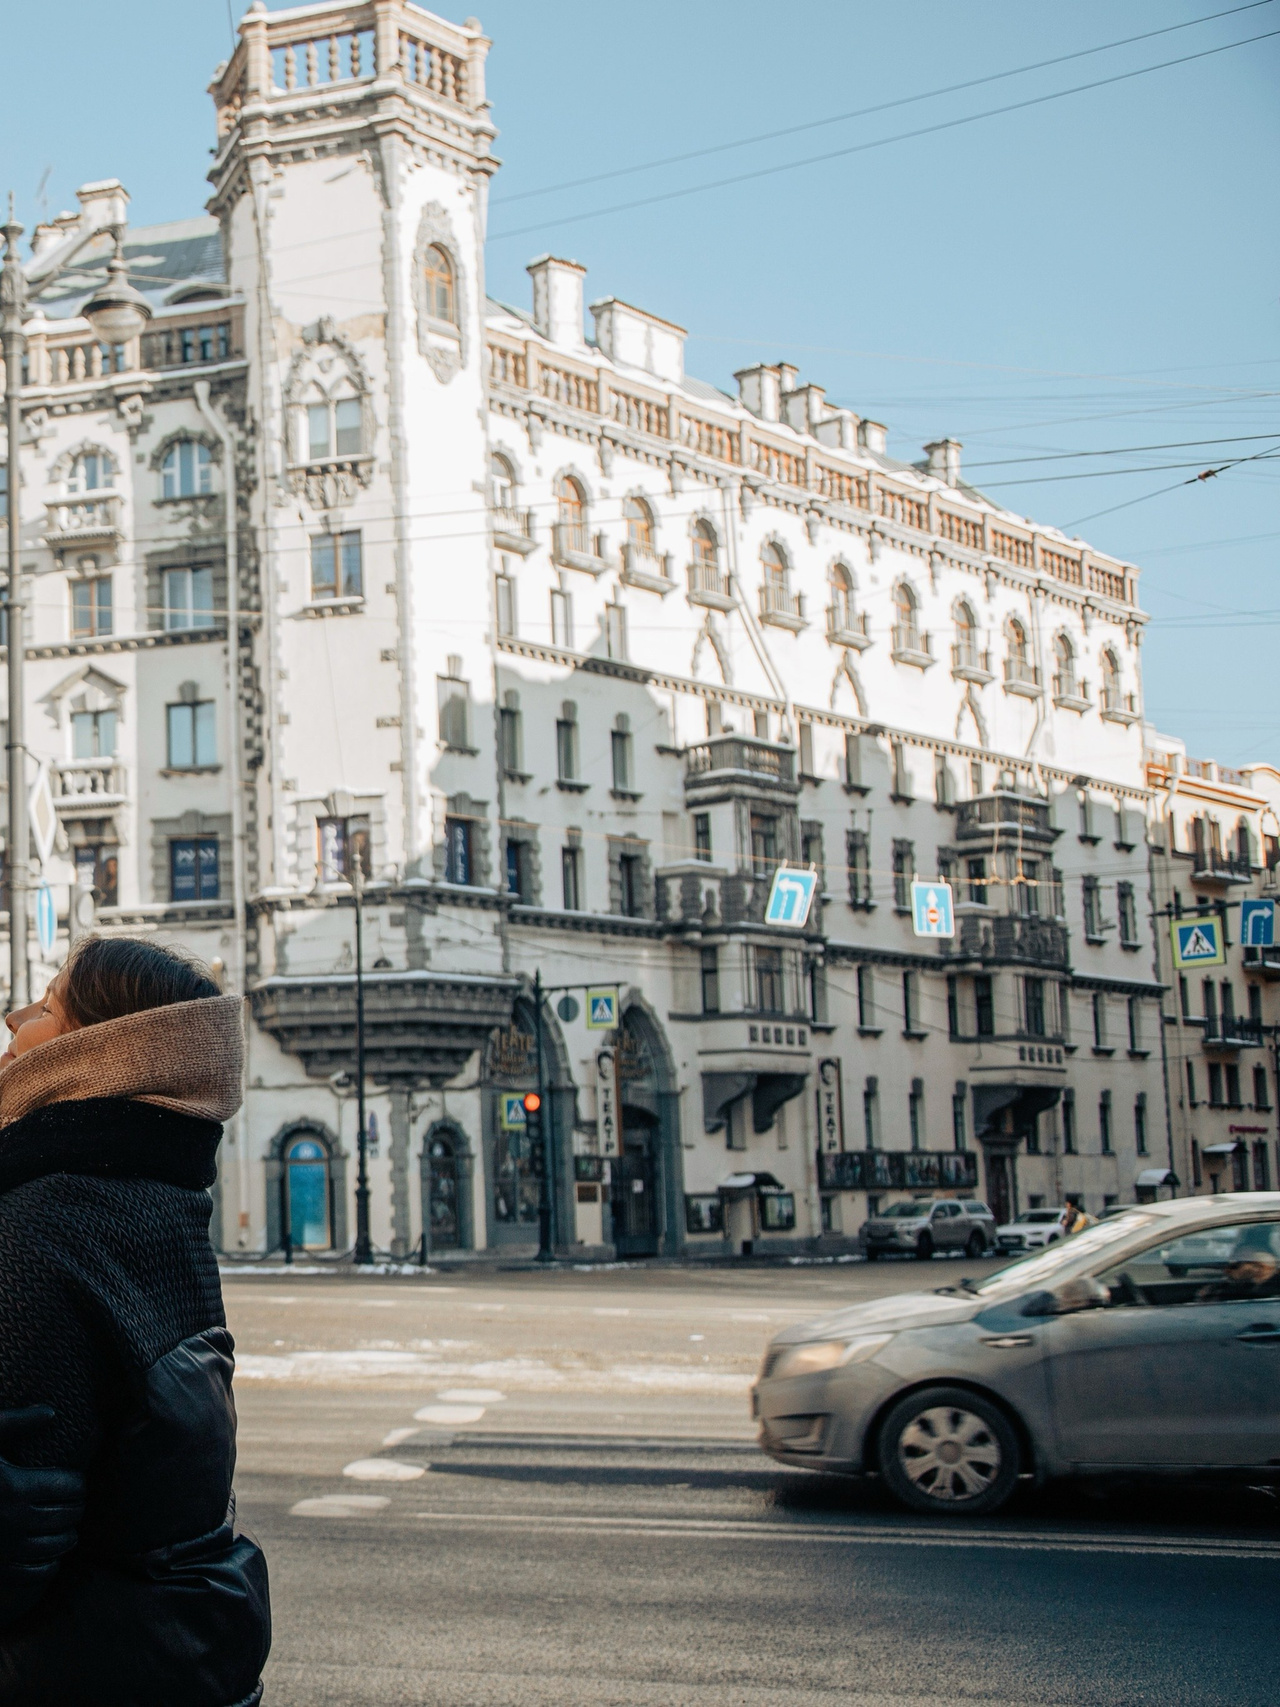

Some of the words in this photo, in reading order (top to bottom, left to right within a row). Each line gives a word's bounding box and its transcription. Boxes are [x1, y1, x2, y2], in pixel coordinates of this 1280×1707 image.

[454, 826, 466, 884] SALE
[602, 1087, 615, 1152] ТЕАТР
[825, 1091, 837, 1150] ТЕАТР
